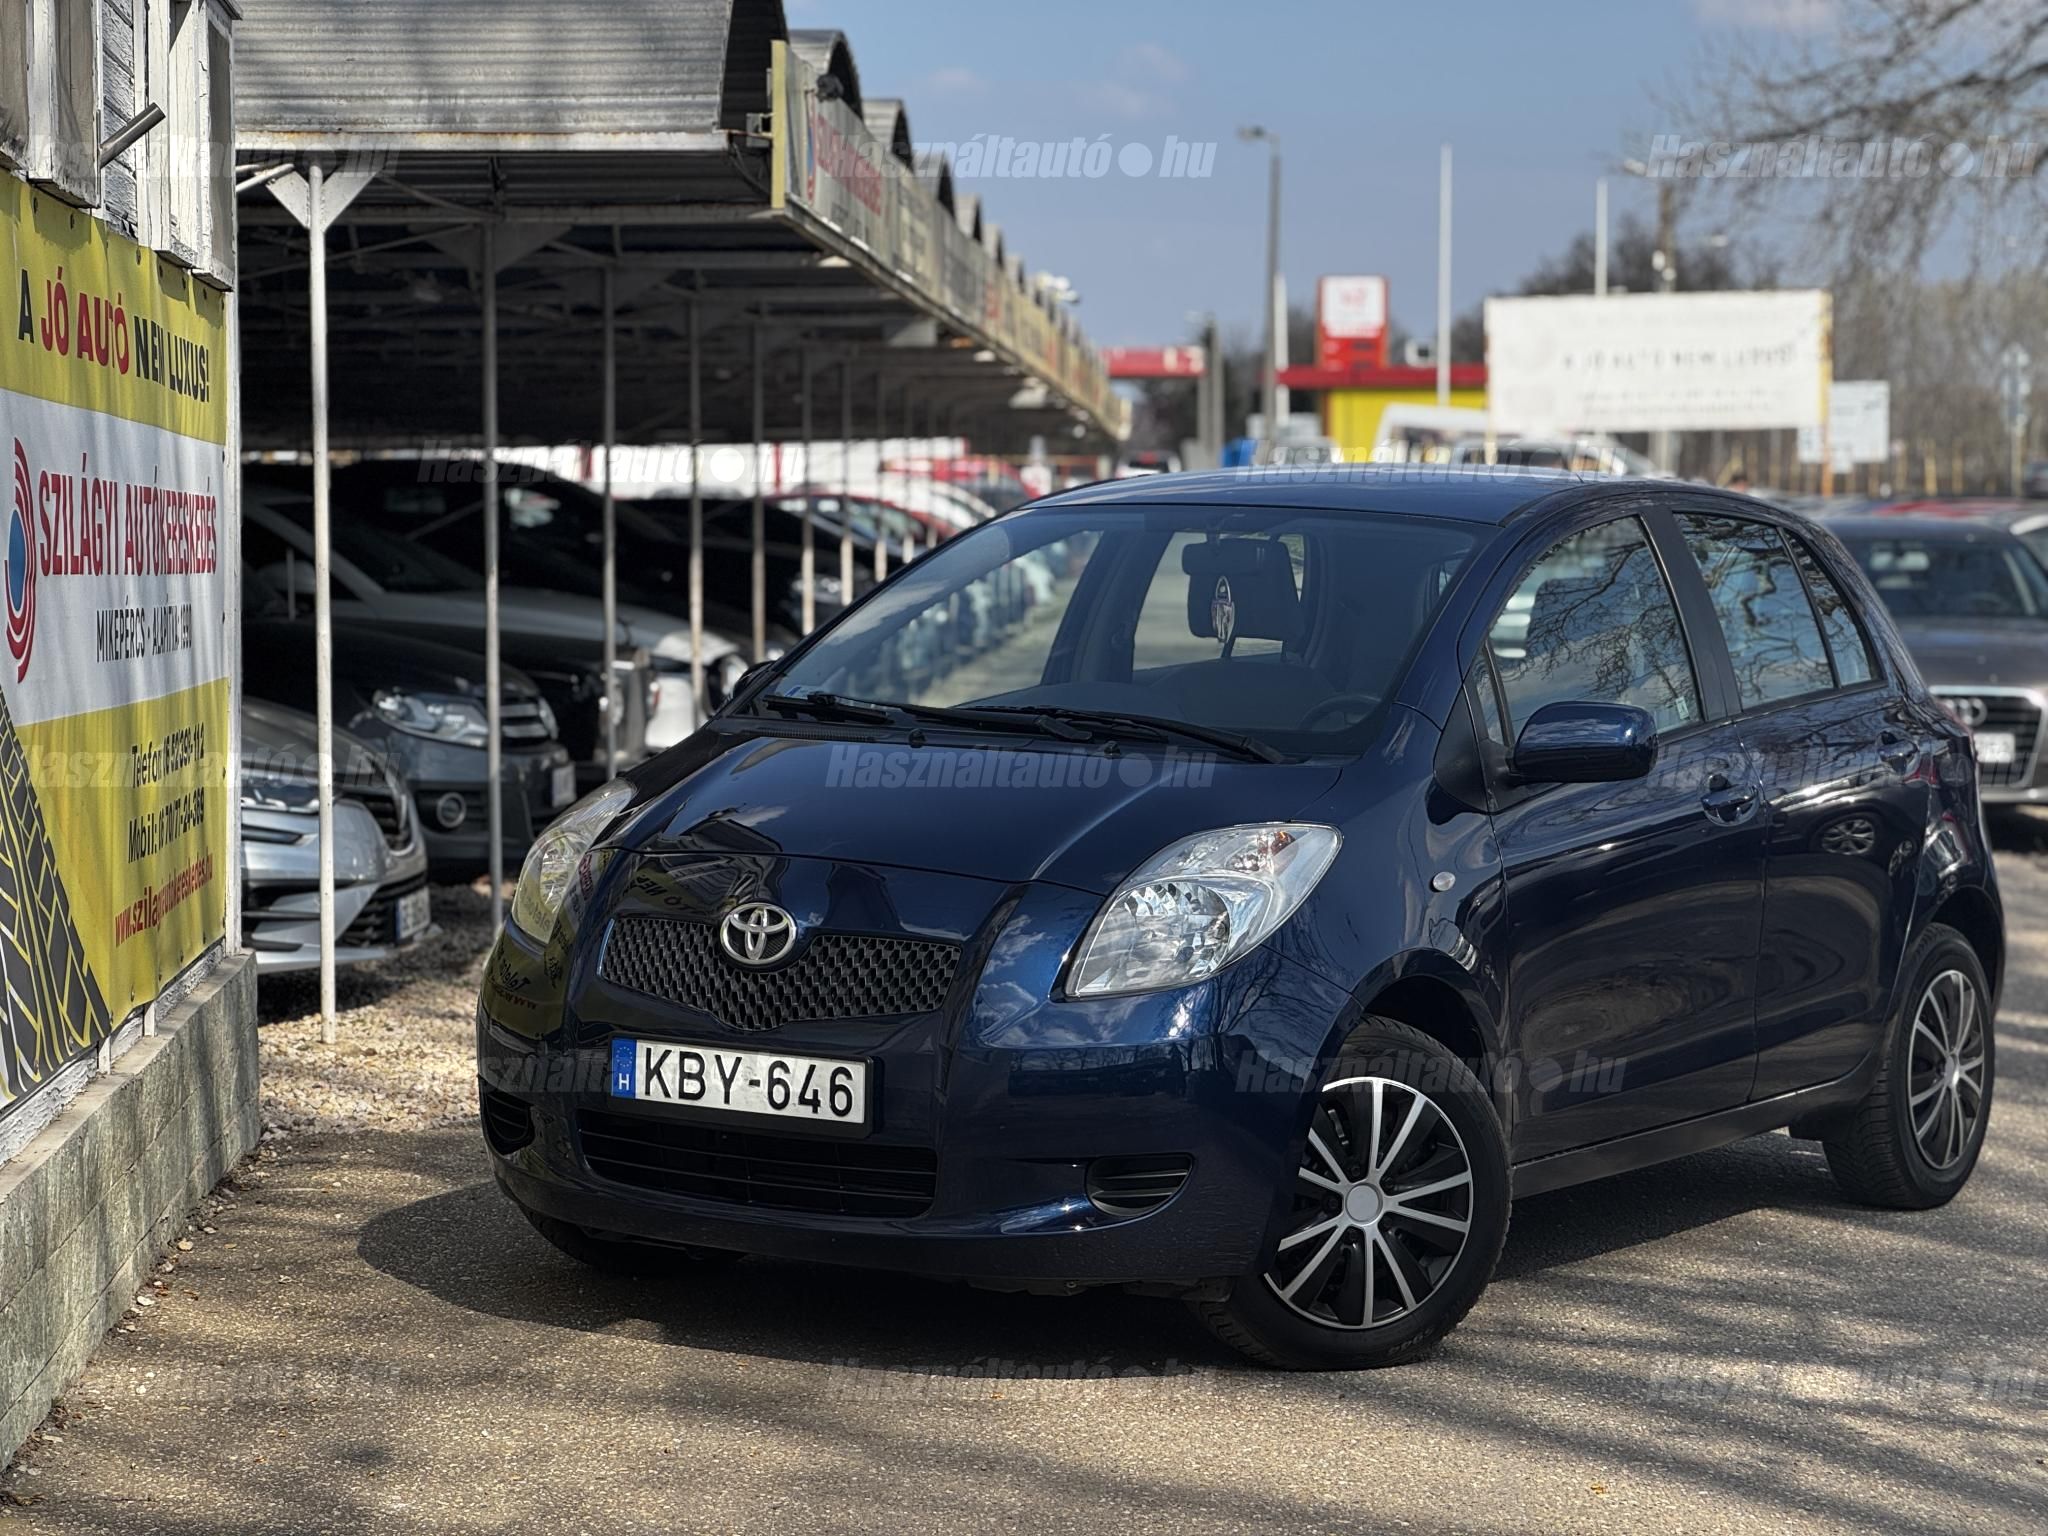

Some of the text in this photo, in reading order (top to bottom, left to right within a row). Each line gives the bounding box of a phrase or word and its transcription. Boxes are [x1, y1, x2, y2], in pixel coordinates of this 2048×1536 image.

[18, 268, 34, 344] A
[41, 266, 69, 356] JÓ
[77, 292, 129, 375] AUTÓ
[167, 331, 210, 403] LUXUS!
[38, 452, 217, 577] SZILÁGYI AUTÓKERESKEDÉS
[96, 595, 145, 663] MIKEPÉRCS
[128, 812, 158, 864] Mobil:
[617, 1046, 855, 1119] H KBY-646
